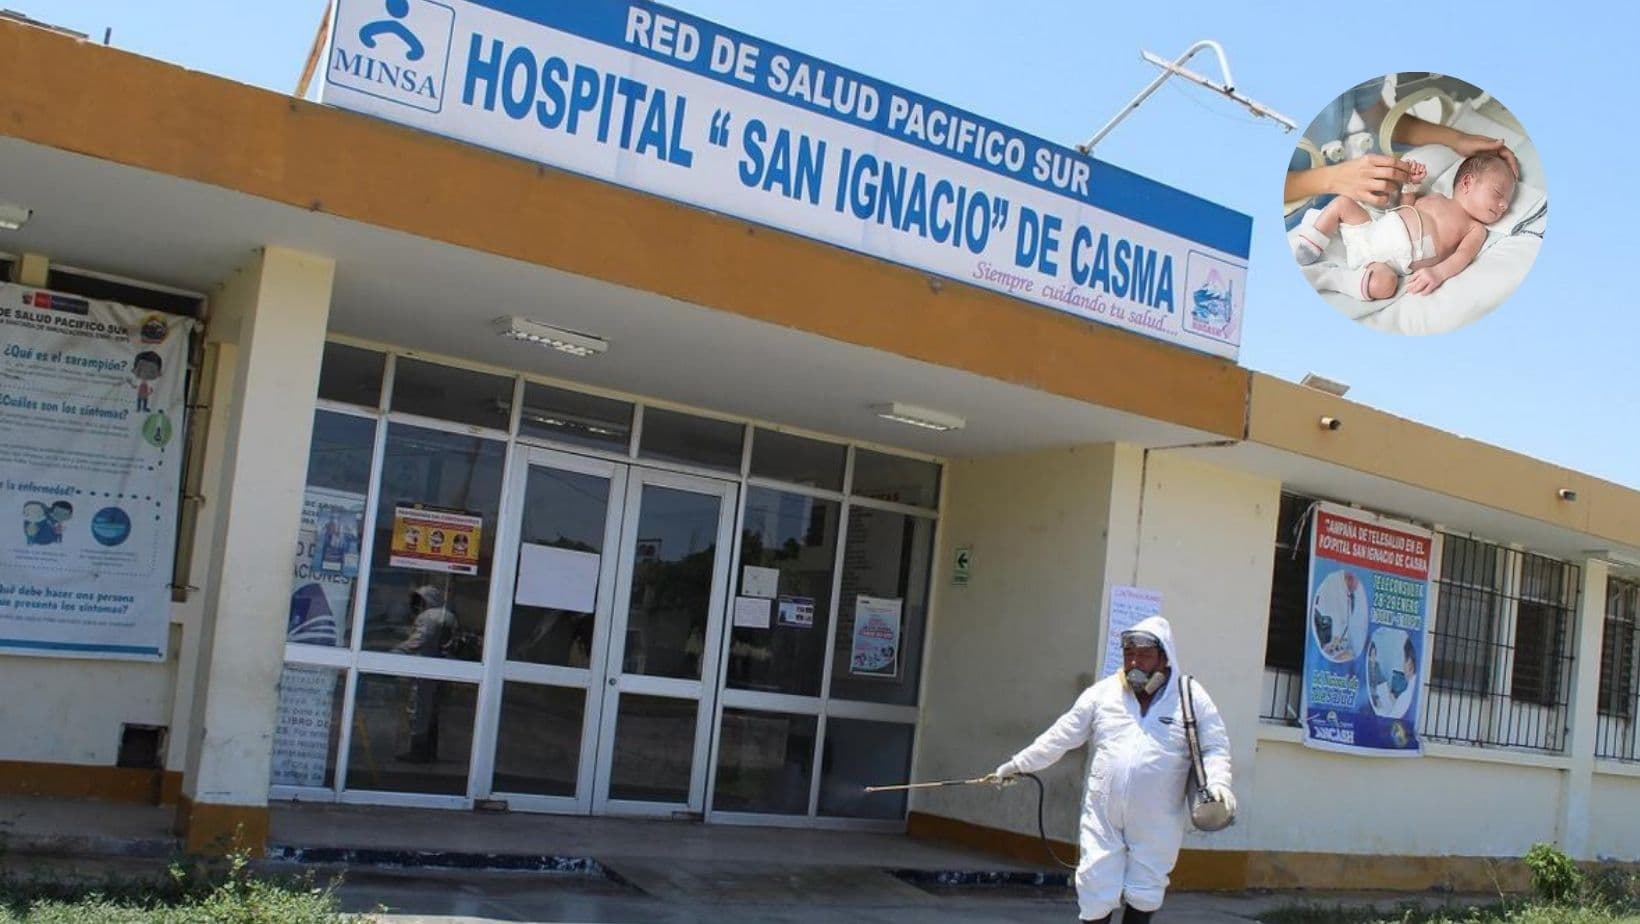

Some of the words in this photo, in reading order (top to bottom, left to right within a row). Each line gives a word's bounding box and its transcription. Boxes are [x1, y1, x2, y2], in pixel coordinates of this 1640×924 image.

[332, 47, 438, 100] MINSA
[625, 6, 700, 63] RED
[709, 35, 760, 84] DE
[767, 54, 881, 122] SALUD
[887, 94, 1026, 172] PACIFICO
[1033, 146, 1091, 197] SUR
[462, 32, 694, 168] HOSPITAL
[1015, 206, 1063, 277] DE
[1070, 224, 1176, 314] CASMA
[972, 261, 1034, 293] Siempre
[1042, 284, 1106, 315] cuidando
[1110, 303, 1125, 321] tu
[15, 309, 52, 324] SALUD
[54, 316, 105, 332] PACIFICO
[4, 344, 33, 359] ¿Qué
[36, 352, 49, 362] es
[52, 351, 62, 363] el
[65, 356, 129, 372] sarampión?
[41, 400, 58, 412] son
[62, 400, 77, 414] los
[79, 404, 129, 420] síntomas?
[1416, 541, 1425, 555] EL
[18, 584, 42, 597] debe
[45, 586, 73, 599] hacer
[97, 592, 135, 604] persona
